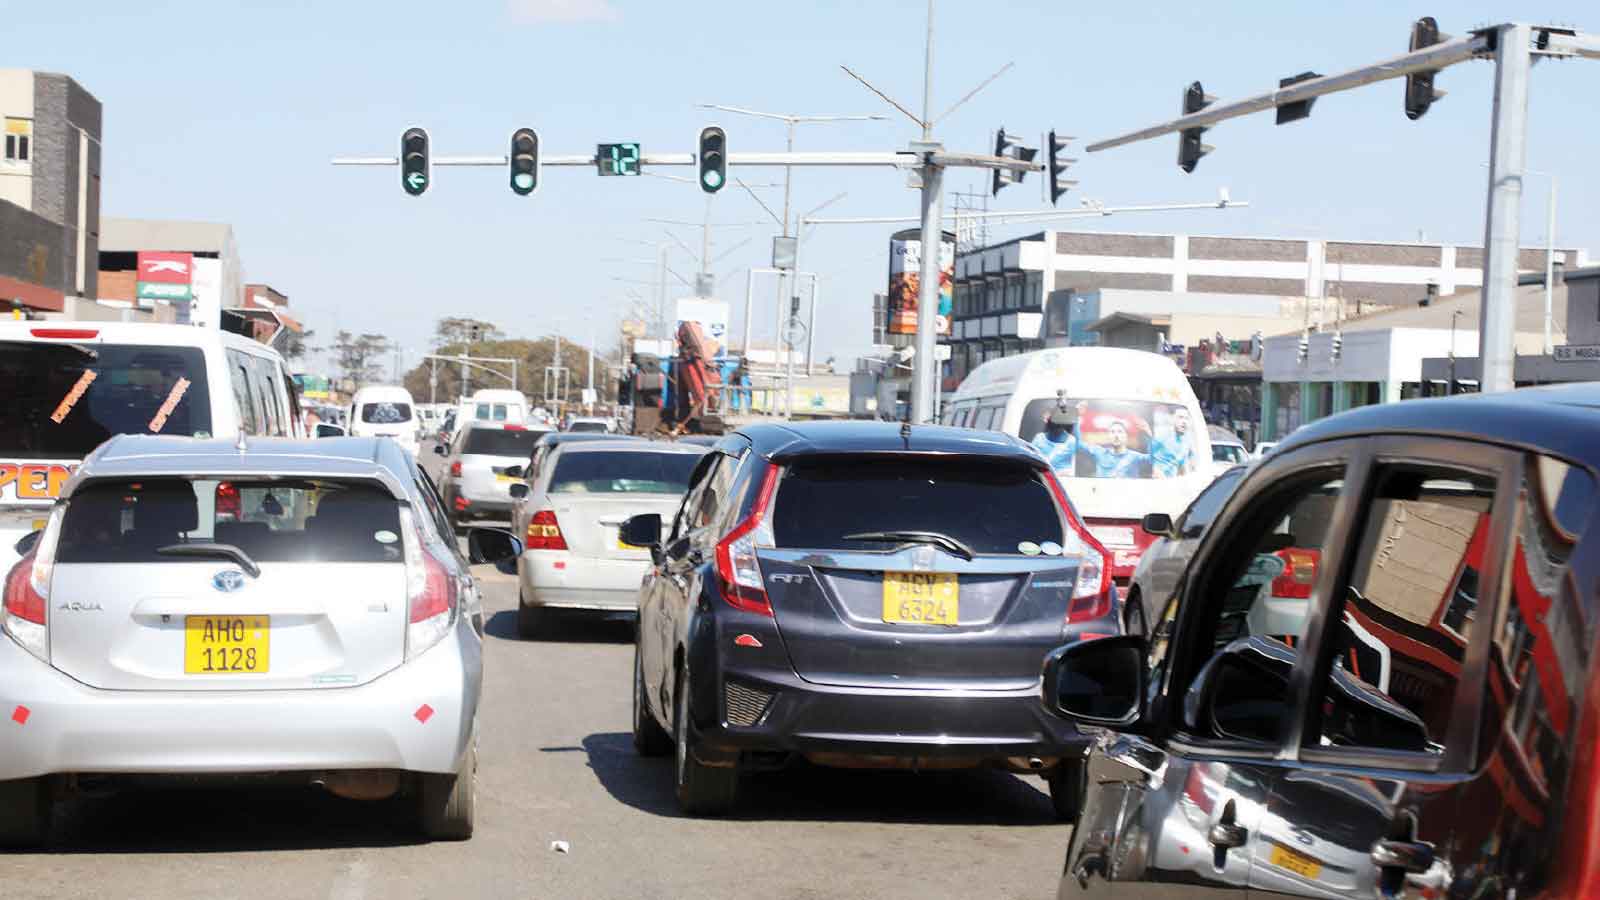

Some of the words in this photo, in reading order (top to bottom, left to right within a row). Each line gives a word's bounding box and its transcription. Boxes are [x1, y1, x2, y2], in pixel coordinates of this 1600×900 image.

[611, 144, 639, 176] 12
[57, 601, 104, 611] AQUA
[898, 599, 948, 622] 6324
[201, 647, 258, 672] 1128
